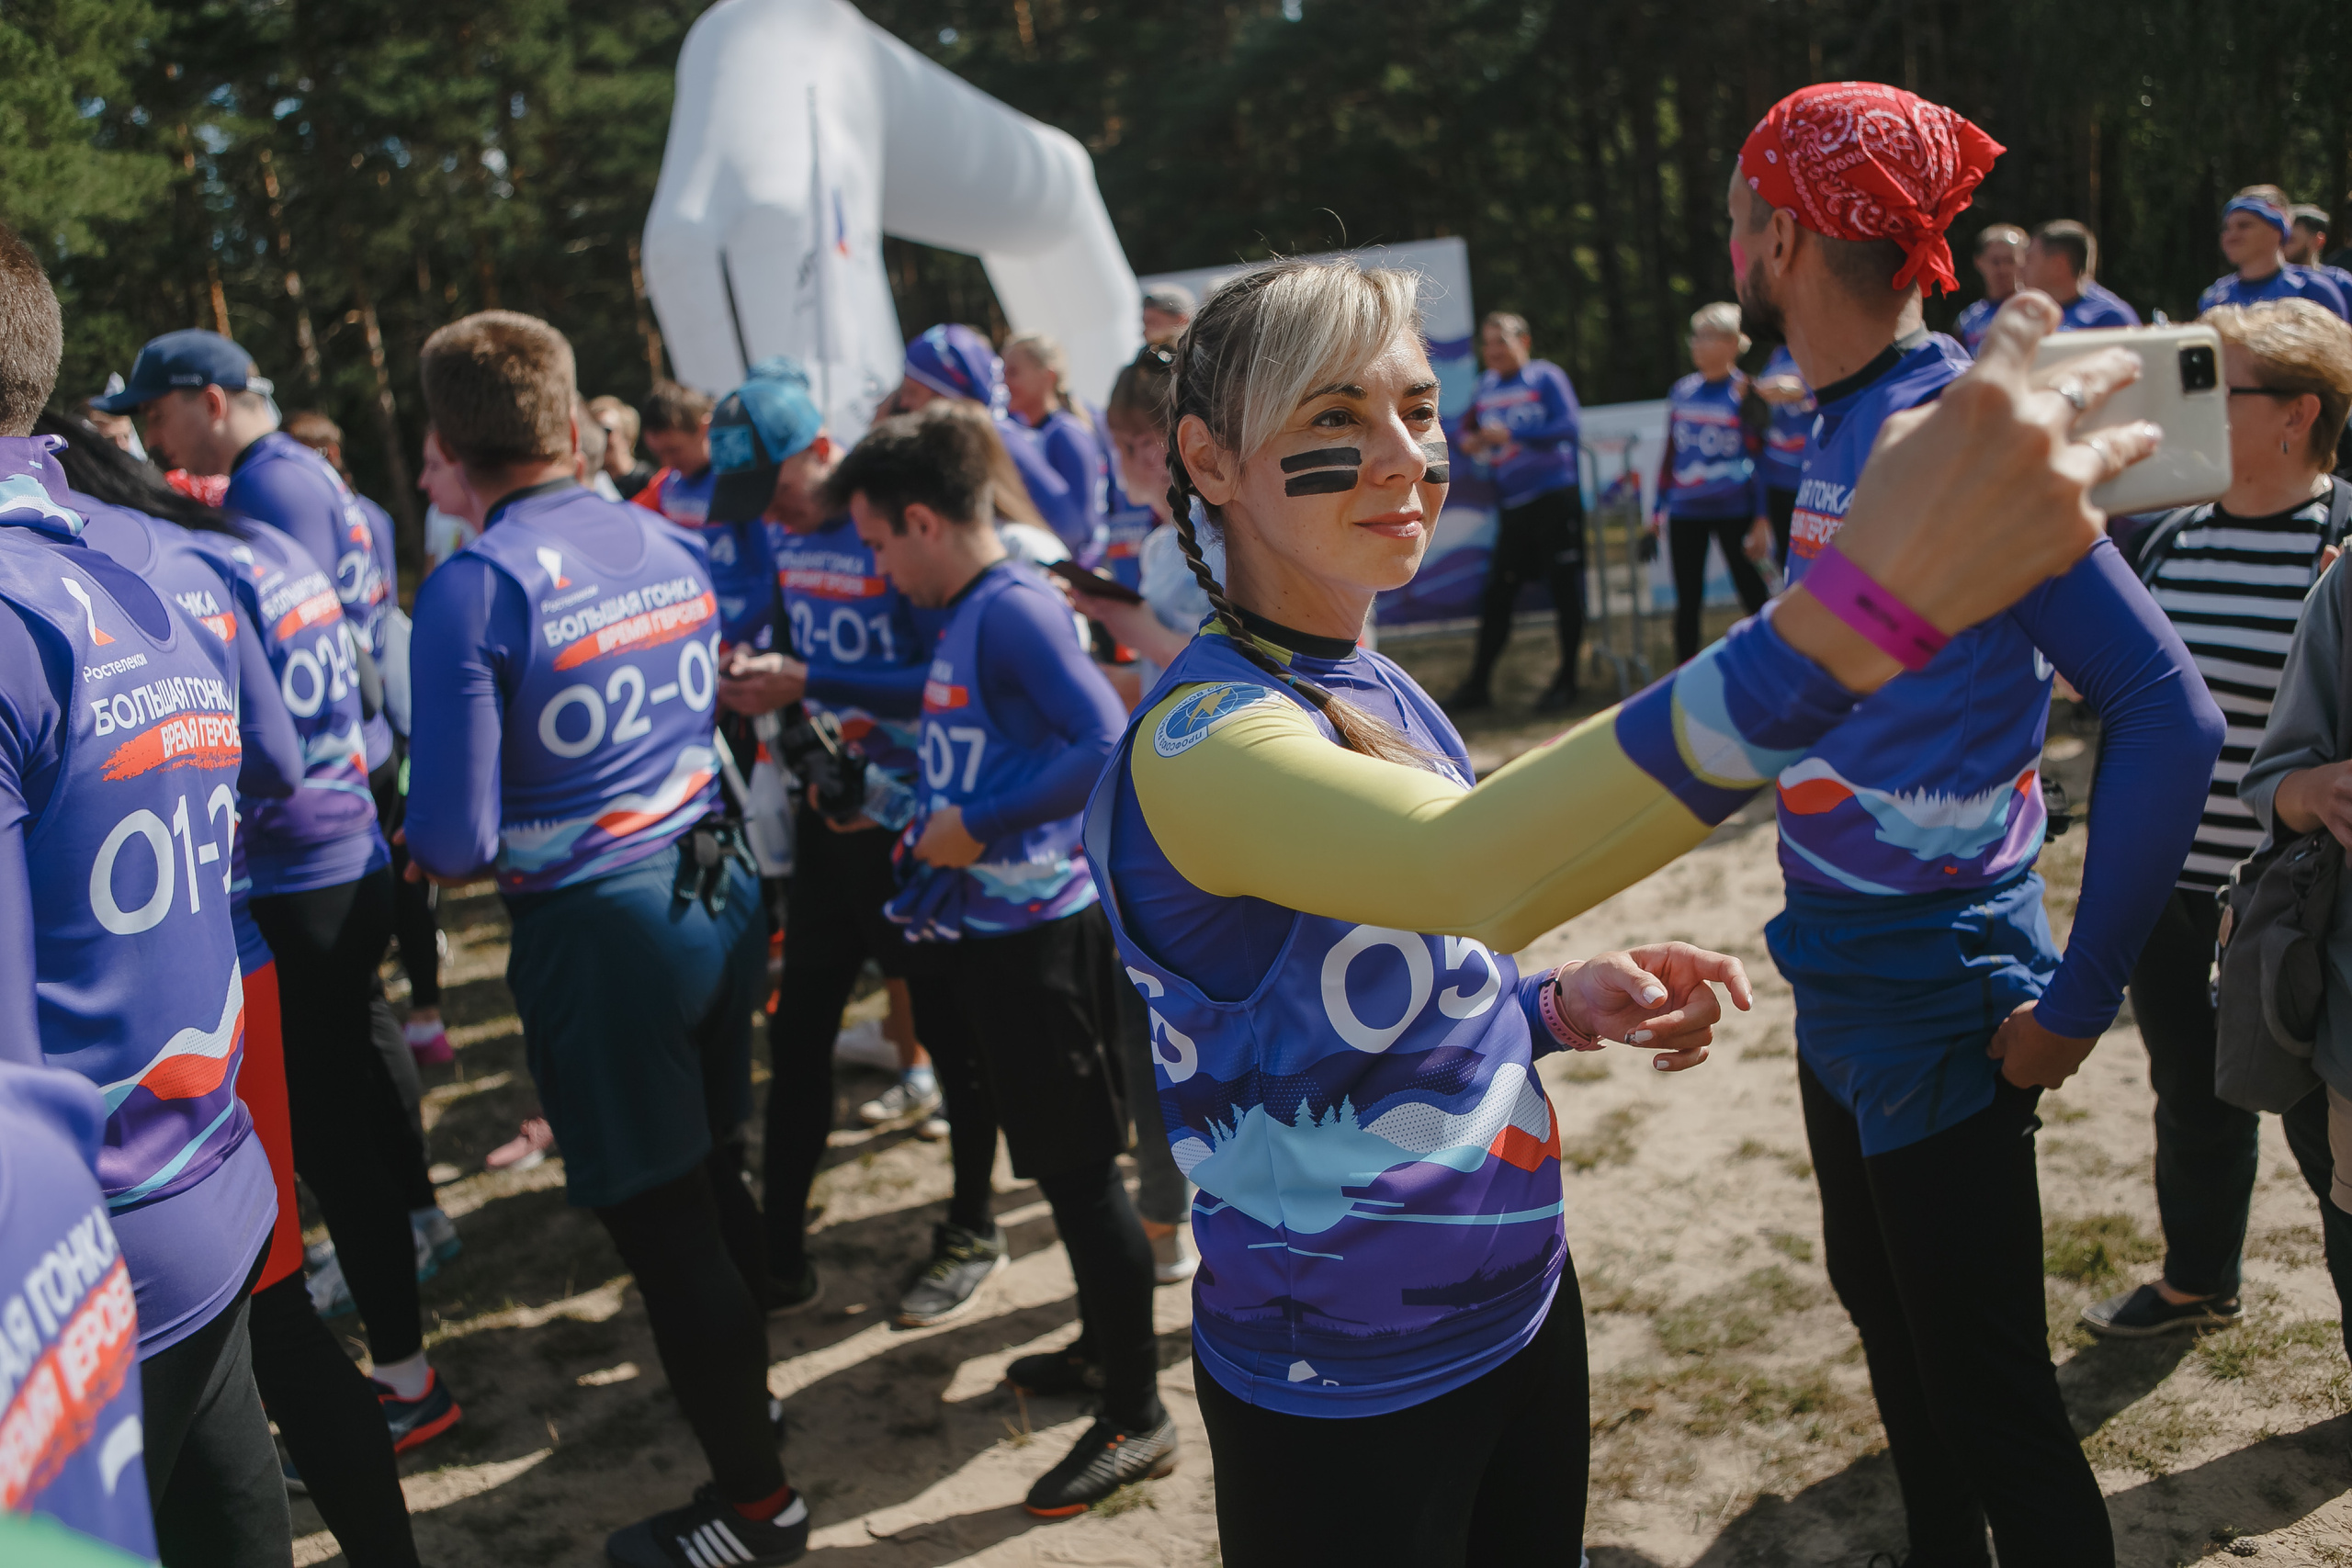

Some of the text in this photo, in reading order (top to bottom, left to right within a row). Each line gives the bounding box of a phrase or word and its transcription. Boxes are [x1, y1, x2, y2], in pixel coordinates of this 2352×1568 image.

[543, 575, 702, 648] БОЛЬШАЯ ГОНКА
[83, 653, 148, 682] Ростелеком
[90, 676, 186, 737] БОЛЬШАЯ
[160, 716, 242, 758] ВРЕМЯ ГЕРОЕ
